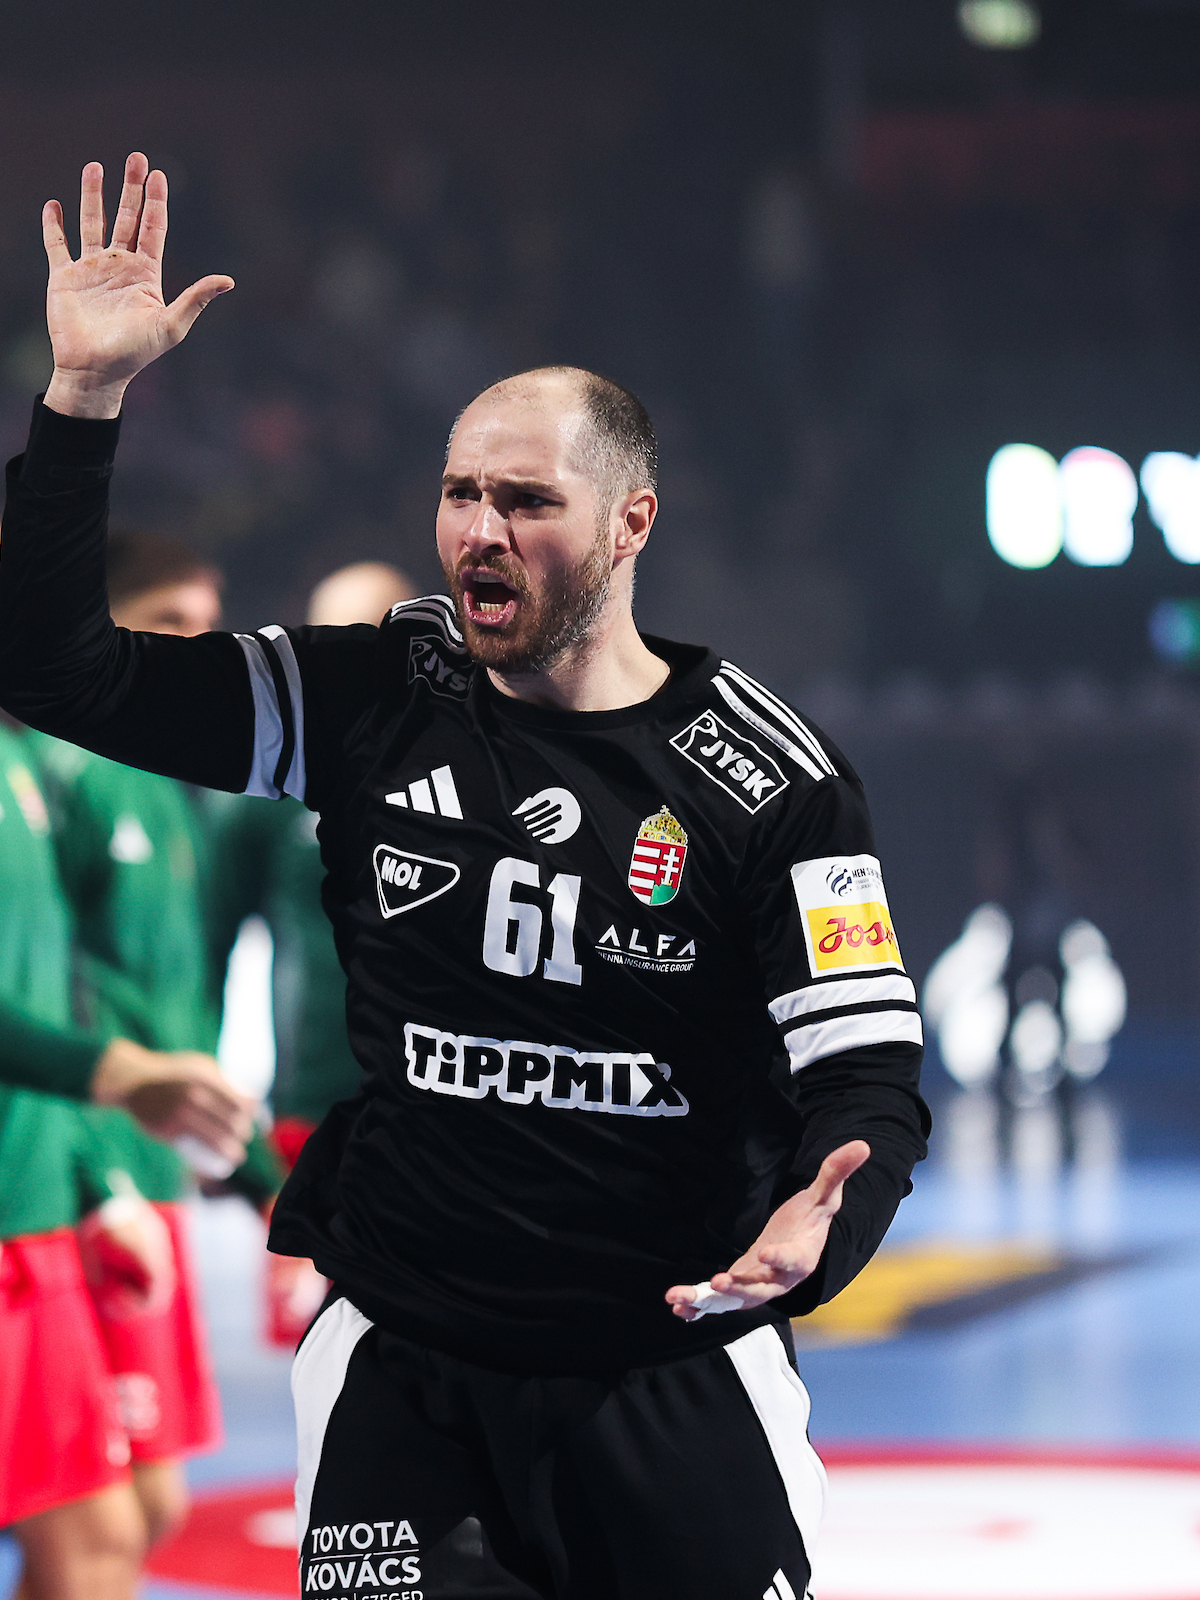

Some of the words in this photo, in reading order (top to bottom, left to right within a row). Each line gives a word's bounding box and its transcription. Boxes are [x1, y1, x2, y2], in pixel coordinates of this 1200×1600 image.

[423, 651, 473, 692] JYS
[699, 739, 777, 802] JYSK
[380, 855, 423, 891] MOL
[482, 856, 583, 987] 61
[598, 923, 697, 956] ALFA
[818, 917, 899, 954] Jos
[597, 951, 624, 966] ENNA
[623, 956, 669, 973] INSURANCE
[311, 1519, 420, 1555] TOYOTA
[304, 1552, 422, 1592] KOVÁCS
